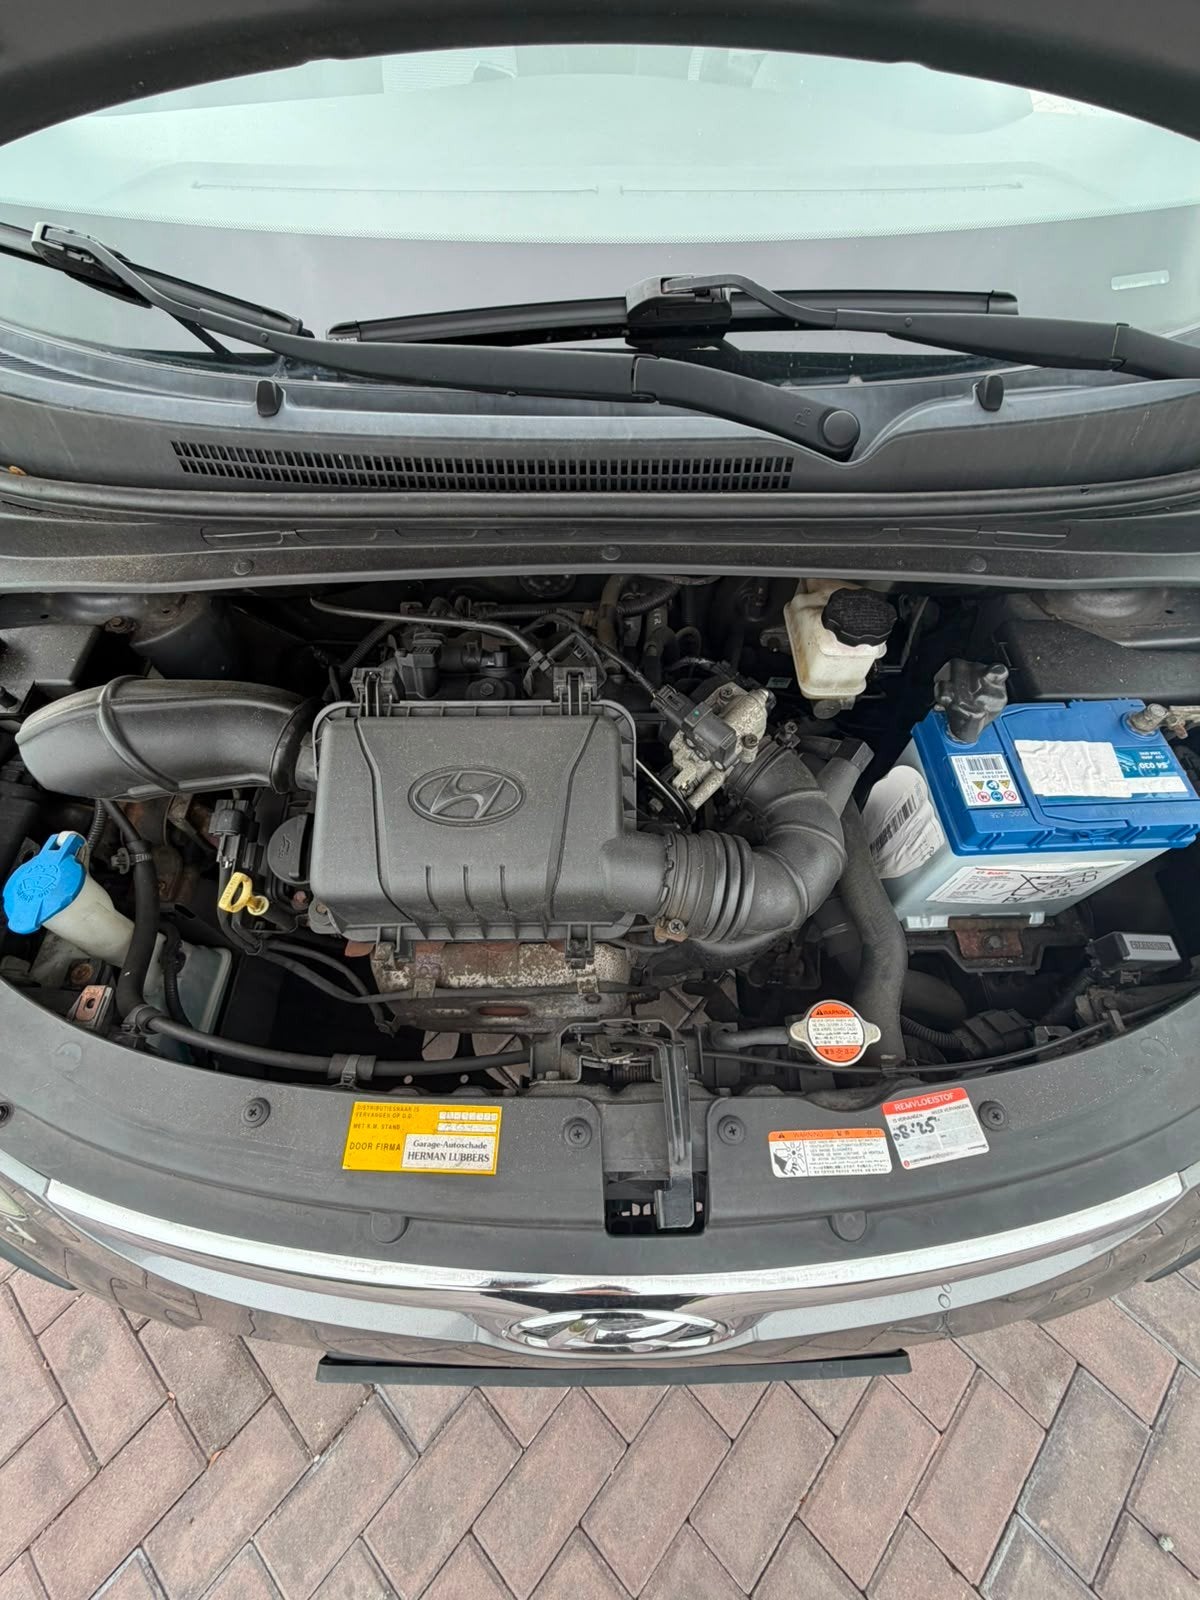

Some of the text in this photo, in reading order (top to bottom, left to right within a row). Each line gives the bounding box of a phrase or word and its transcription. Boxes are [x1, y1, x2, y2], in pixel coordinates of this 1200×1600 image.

[894, 1092, 954, 1112] REMVLOEISTOF
[350, 1142, 401, 1151] DOOR FIRMA
[412, 1140, 488, 1150] Garage-Autoschade
[407, 1151, 490, 1162] HERMAN LUBBERS
